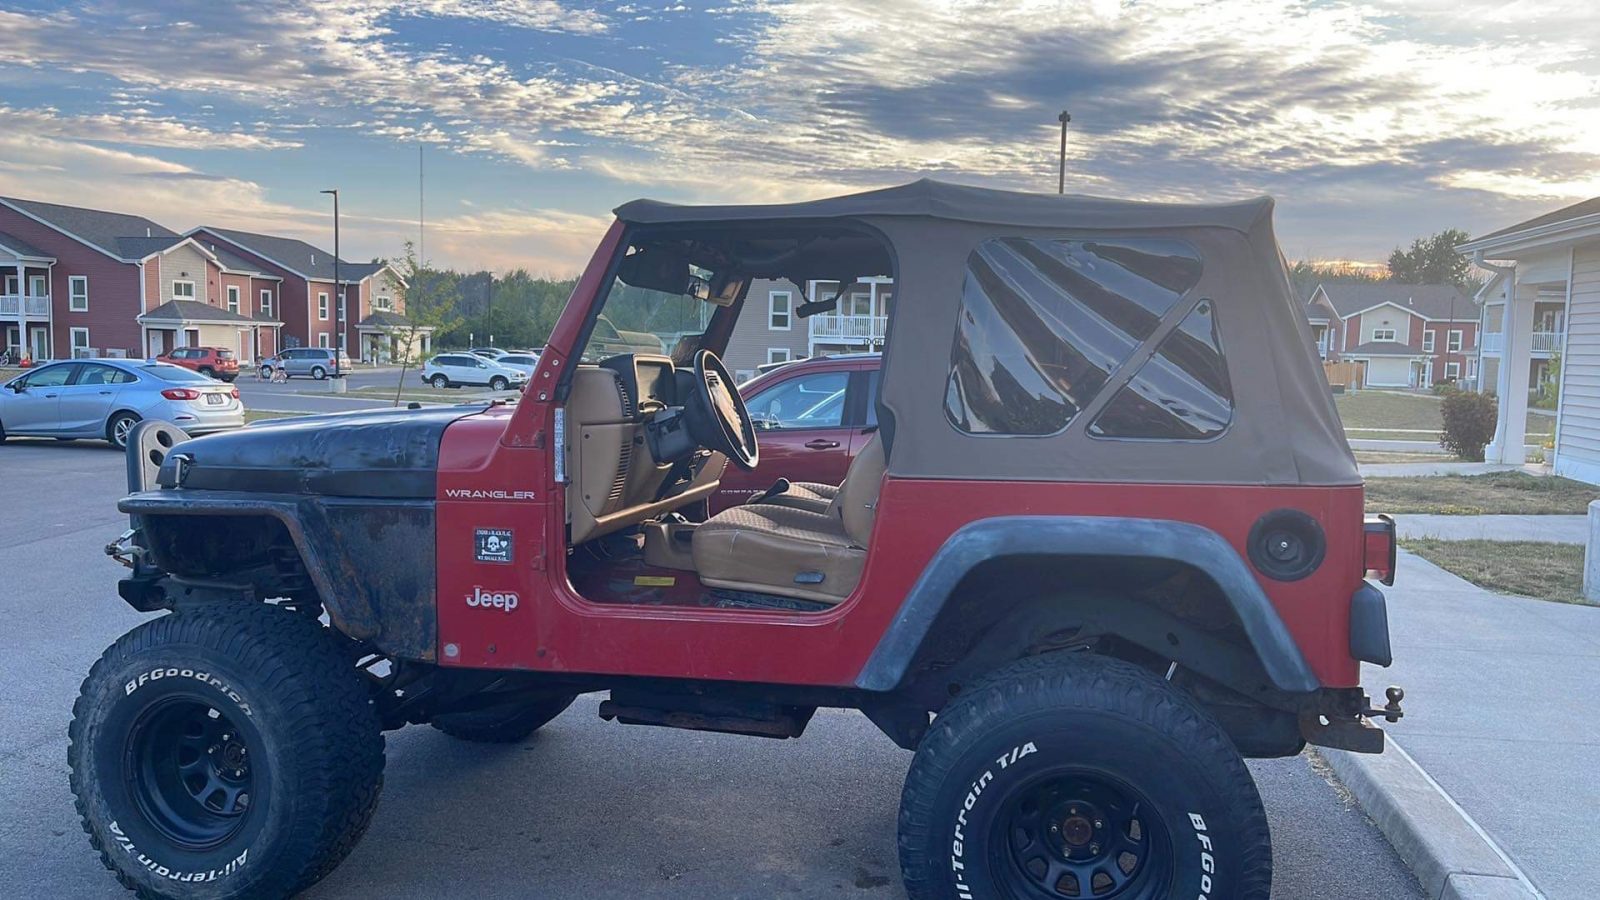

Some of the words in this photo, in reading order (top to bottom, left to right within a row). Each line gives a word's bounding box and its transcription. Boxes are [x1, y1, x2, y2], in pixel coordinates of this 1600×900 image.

[445, 489, 535, 500] WRANGLER
[465, 587, 519, 612] Jeep
[125, 667, 253, 717] BFGoodrich
[108, 819, 135, 855] T/A
[951, 770, 994, 900] ll-Terrain
[995, 741, 1039, 769] T/A
[137, 847, 249, 883] All-Terrain
